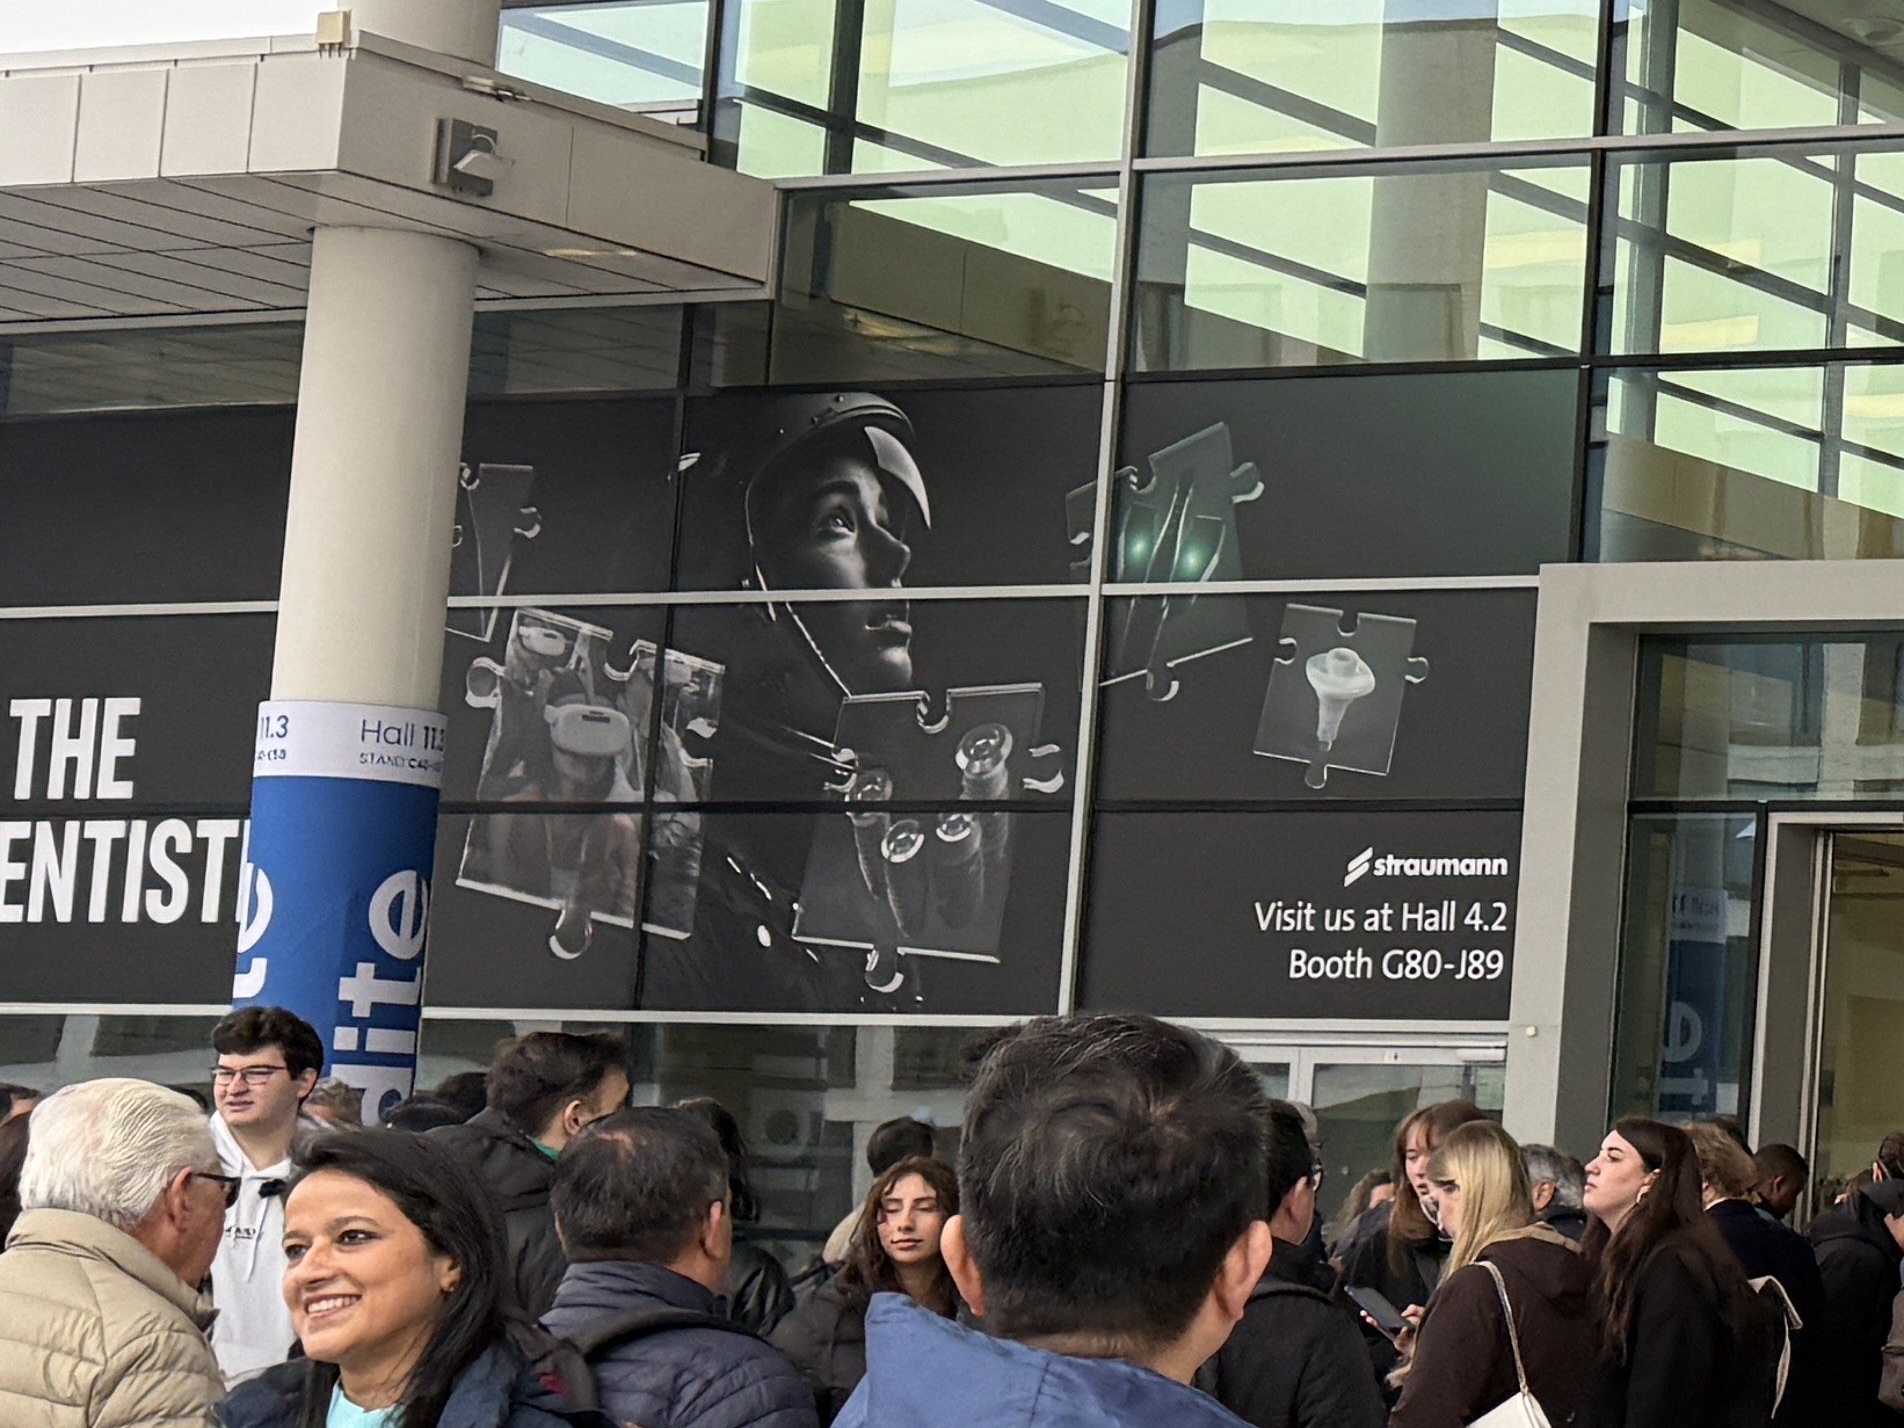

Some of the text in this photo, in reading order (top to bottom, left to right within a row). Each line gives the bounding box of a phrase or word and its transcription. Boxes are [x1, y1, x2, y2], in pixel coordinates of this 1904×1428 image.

[9, 697, 142, 800] THE
[360, 719, 415, 747] Hall
[0, 818, 251, 925] ENTIST
[1373, 853, 1509, 877] straumann
[1254, 899, 1508, 933] Visit us at Hall 4.2
[1288, 946, 1505, 980] Booth G80-J89
